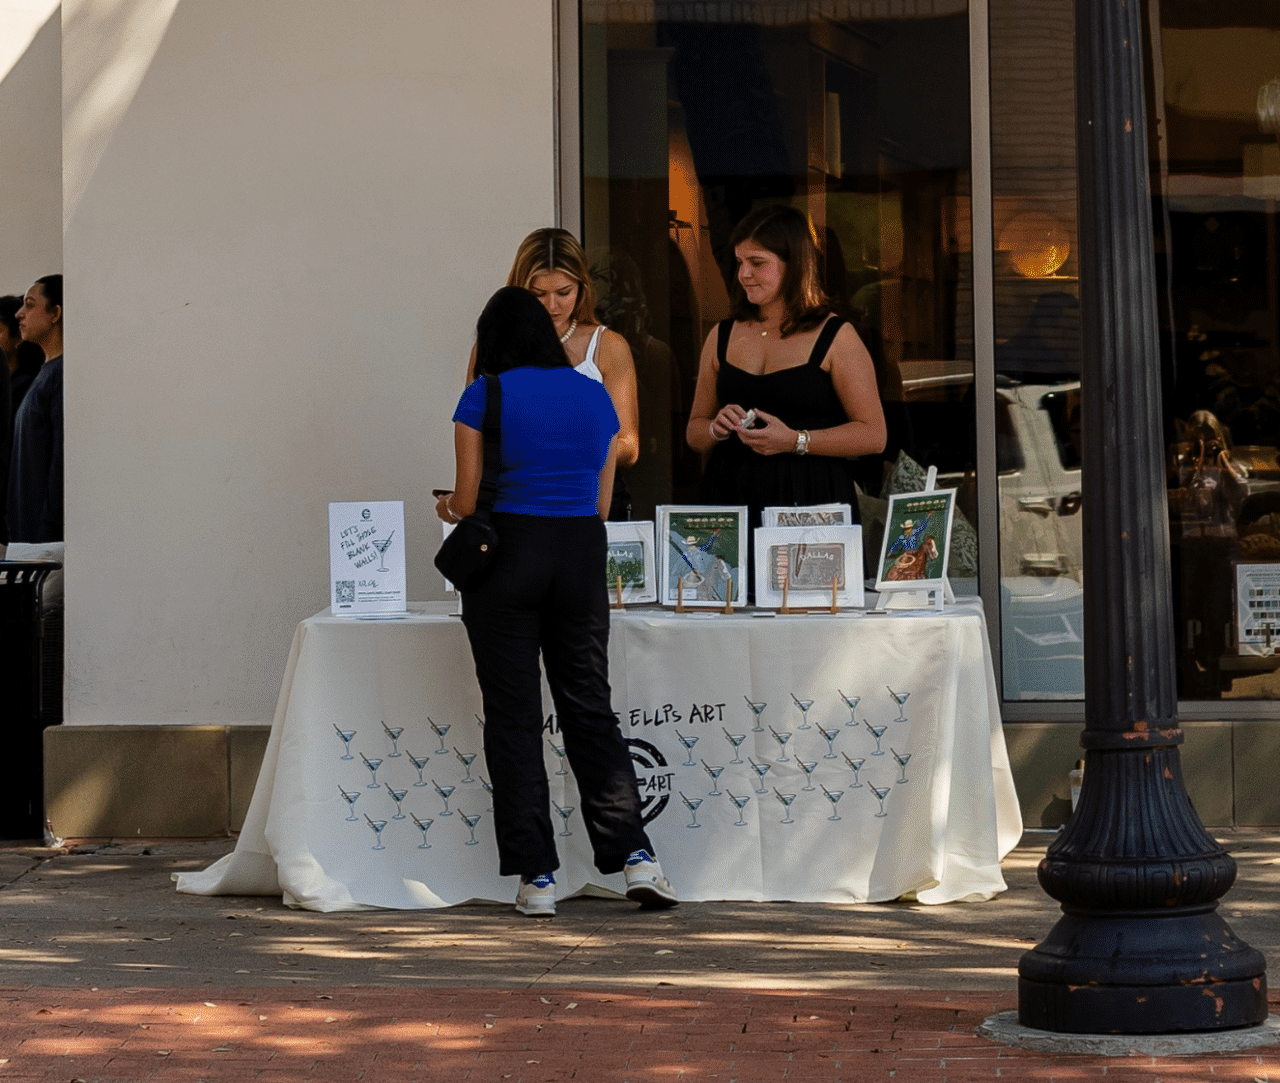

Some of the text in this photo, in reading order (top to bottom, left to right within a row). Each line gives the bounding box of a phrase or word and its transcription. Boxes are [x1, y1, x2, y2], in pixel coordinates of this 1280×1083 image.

[346, 542, 371, 560] BLANK
[800, 552, 835, 561] DALLAS
[688, 703, 726, 724] ART
[645, 772, 676, 792] ART
